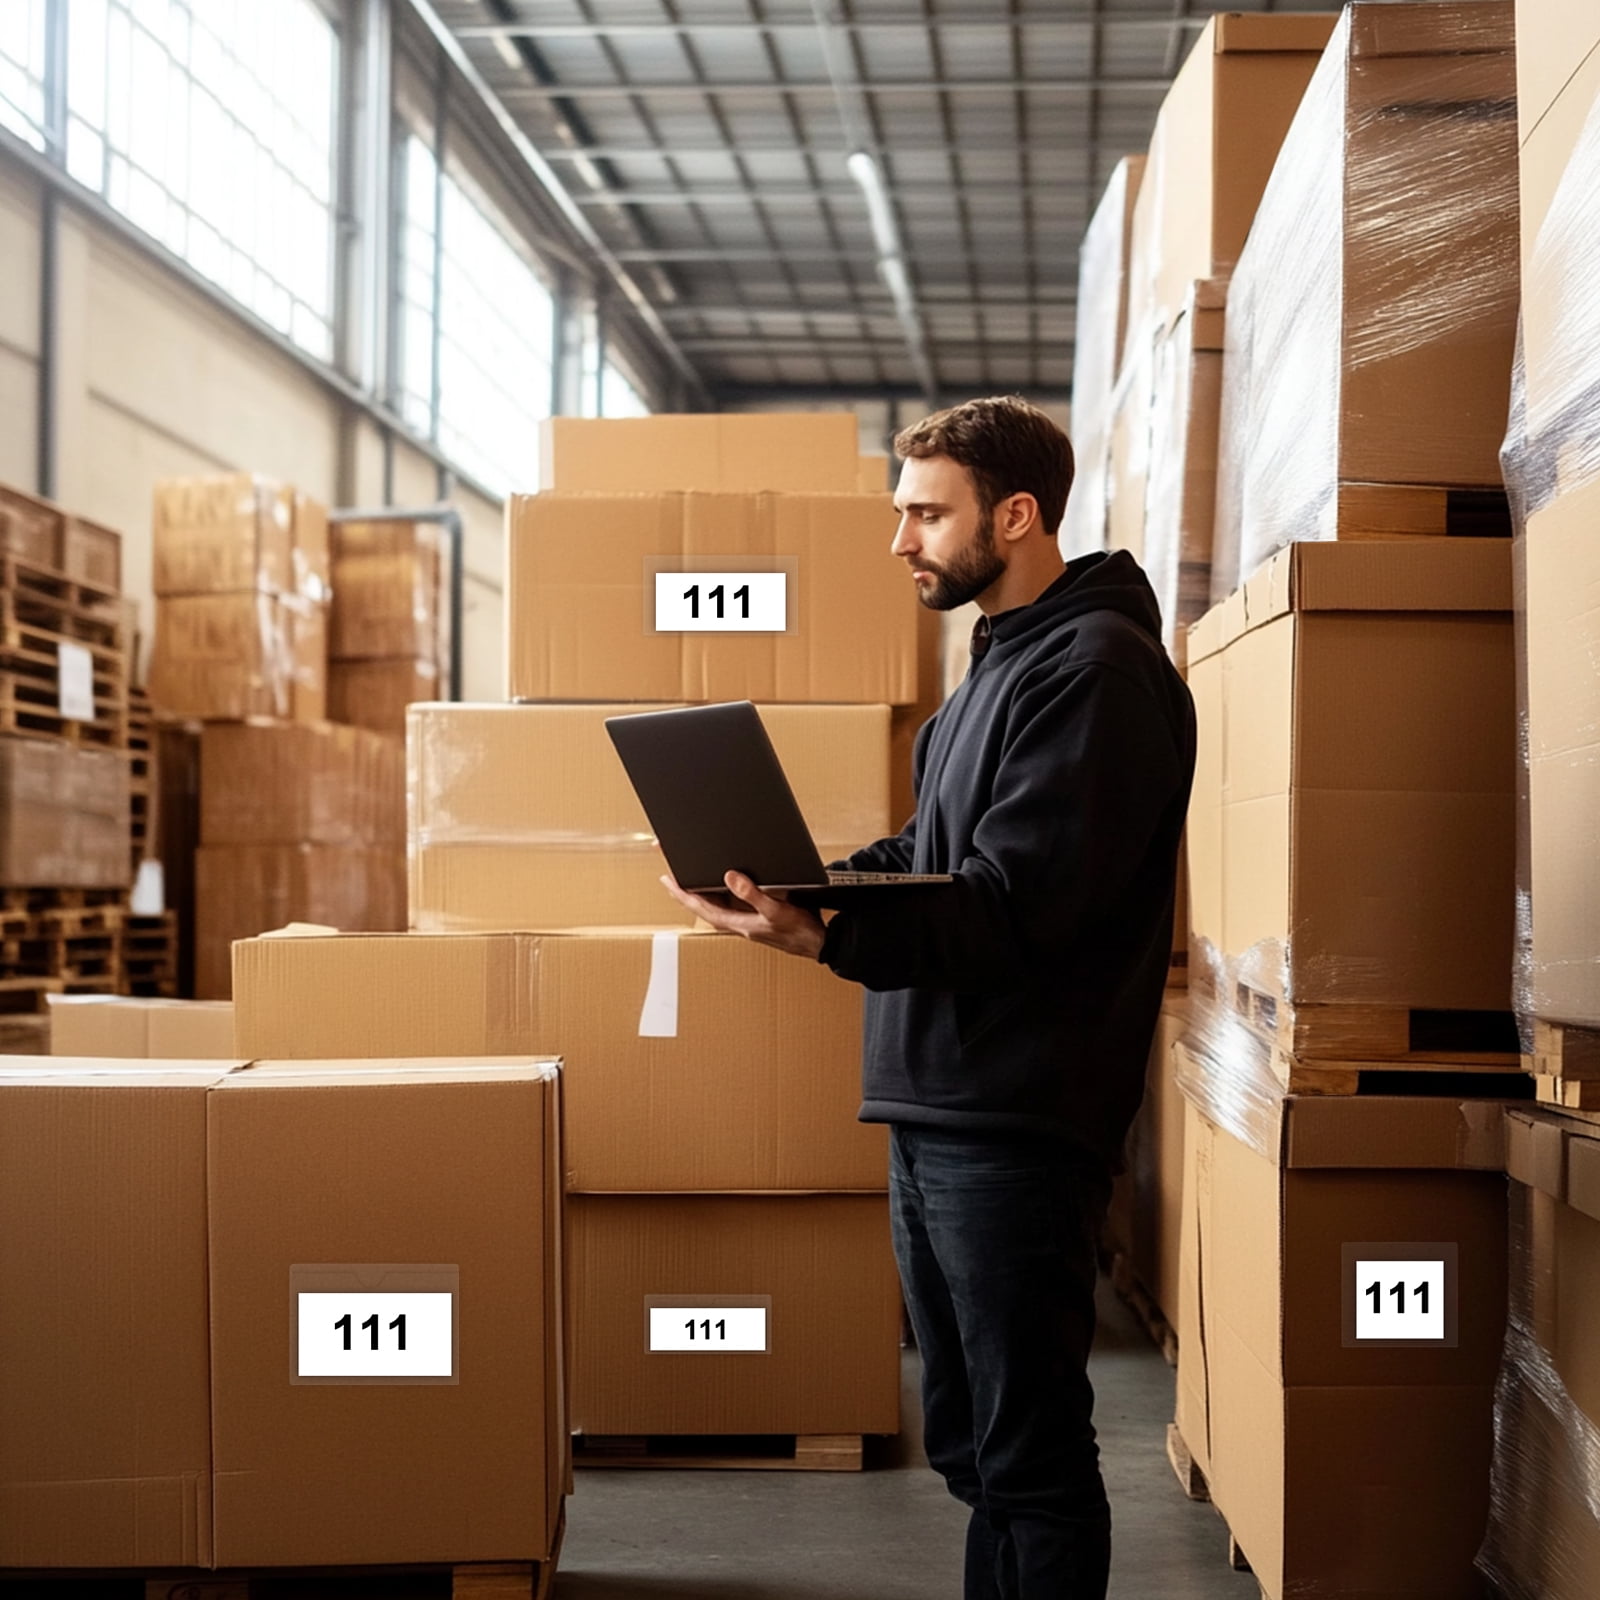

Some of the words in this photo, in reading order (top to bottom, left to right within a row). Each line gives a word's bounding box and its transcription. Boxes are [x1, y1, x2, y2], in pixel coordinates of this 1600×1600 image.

[683, 584, 750, 619] 111
[1365, 1281, 1429, 1314] 111
[334, 1313, 406, 1351] 111
[684, 1319, 725, 1340] 111
